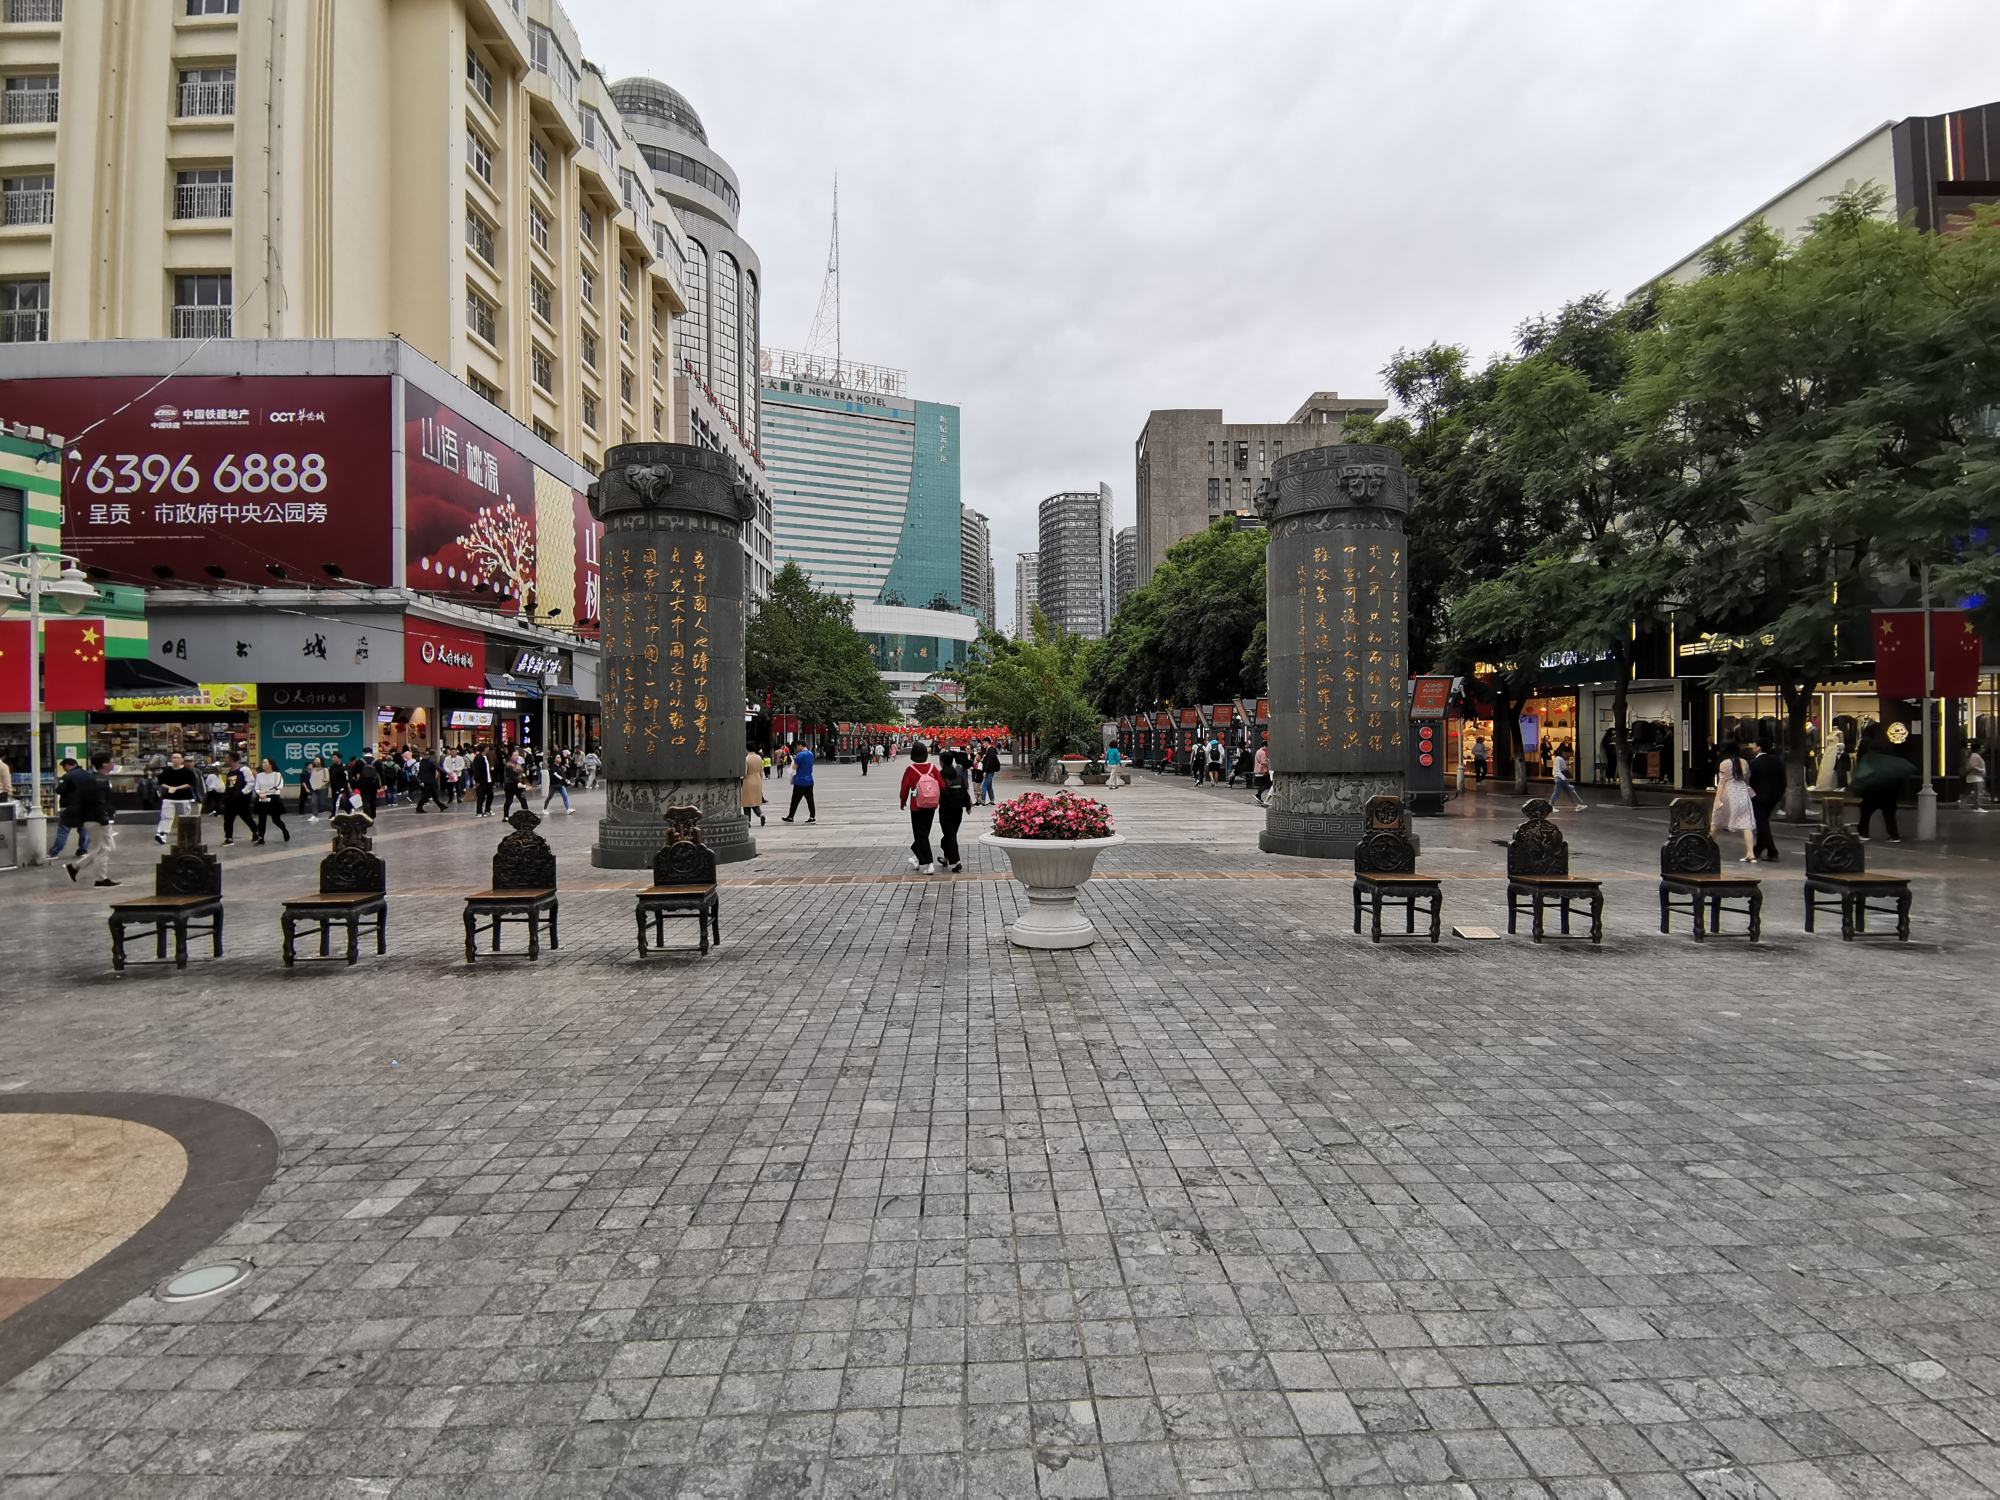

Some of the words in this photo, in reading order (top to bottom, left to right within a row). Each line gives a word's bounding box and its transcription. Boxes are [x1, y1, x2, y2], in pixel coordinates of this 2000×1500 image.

[781, 355, 894, 391] 昆百大集团
[808, 386, 830, 398] NEW
[834, 391, 853, 402] ERA
[856, 394, 887, 407] HOTEL
[182, 408, 250, 420] 中国铁建地产
[269, 411, 295, 423] OCT
[151, 421, 181, 429] 中国铁建
[421, 417, 459, 474] 山语
[939, 415, 948, 464] 新纪元广场
[86, 454, 200, 494] 6396
[213, 453, 328, 494] 6888
[283, 725, 340, 733] watsons
[285, 742, 339, 760] 屈臣氏
